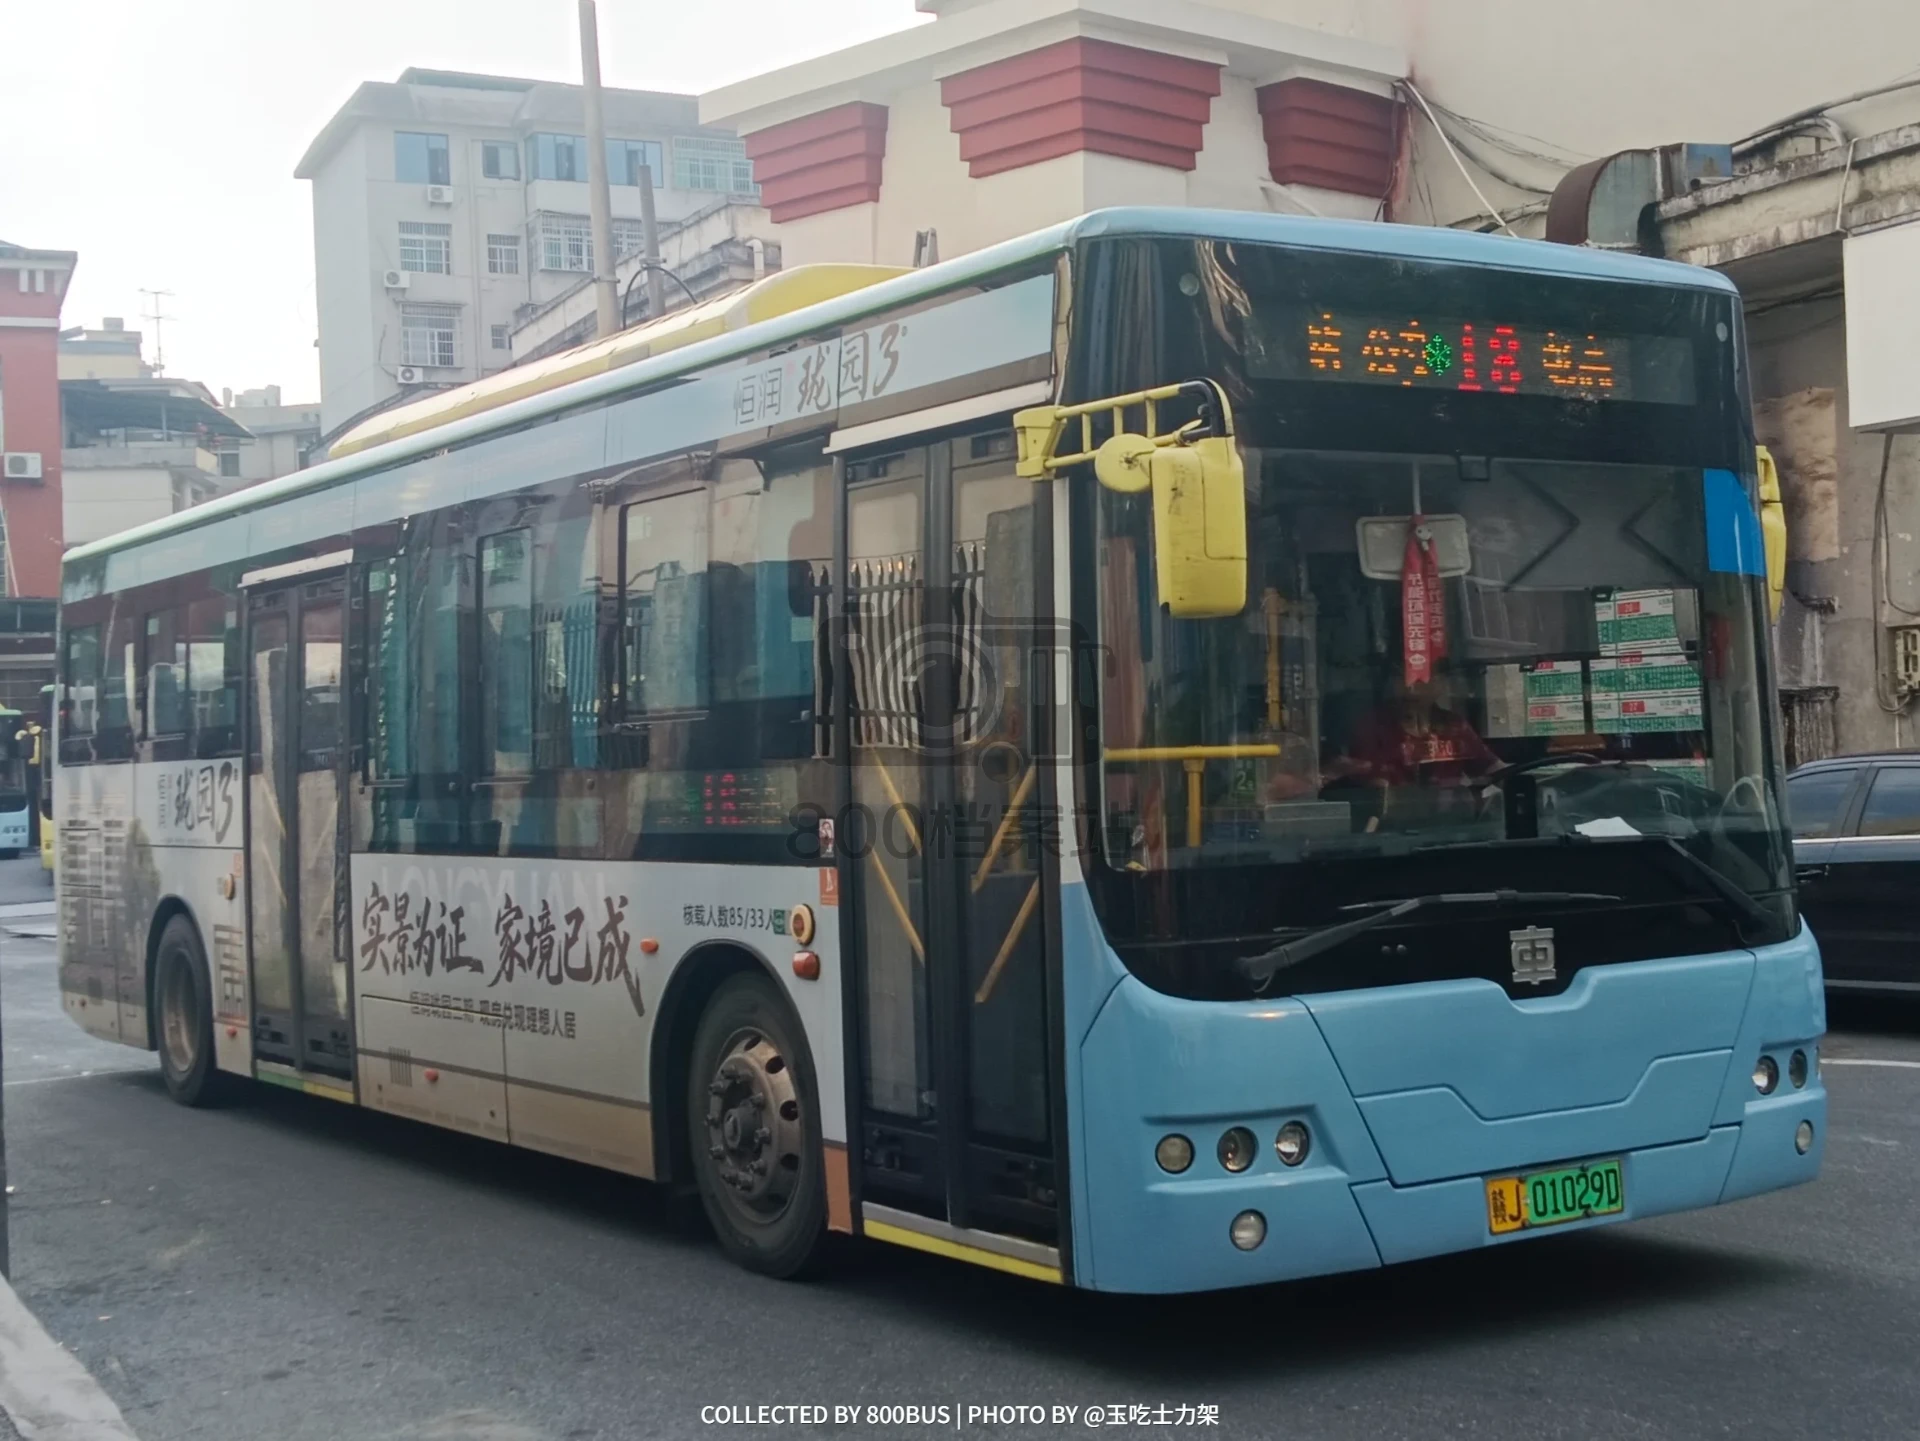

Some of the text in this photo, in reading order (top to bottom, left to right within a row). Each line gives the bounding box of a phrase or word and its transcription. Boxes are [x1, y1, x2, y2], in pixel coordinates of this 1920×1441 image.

[361, 881, 645, 1018] 实景为证 家境已成
